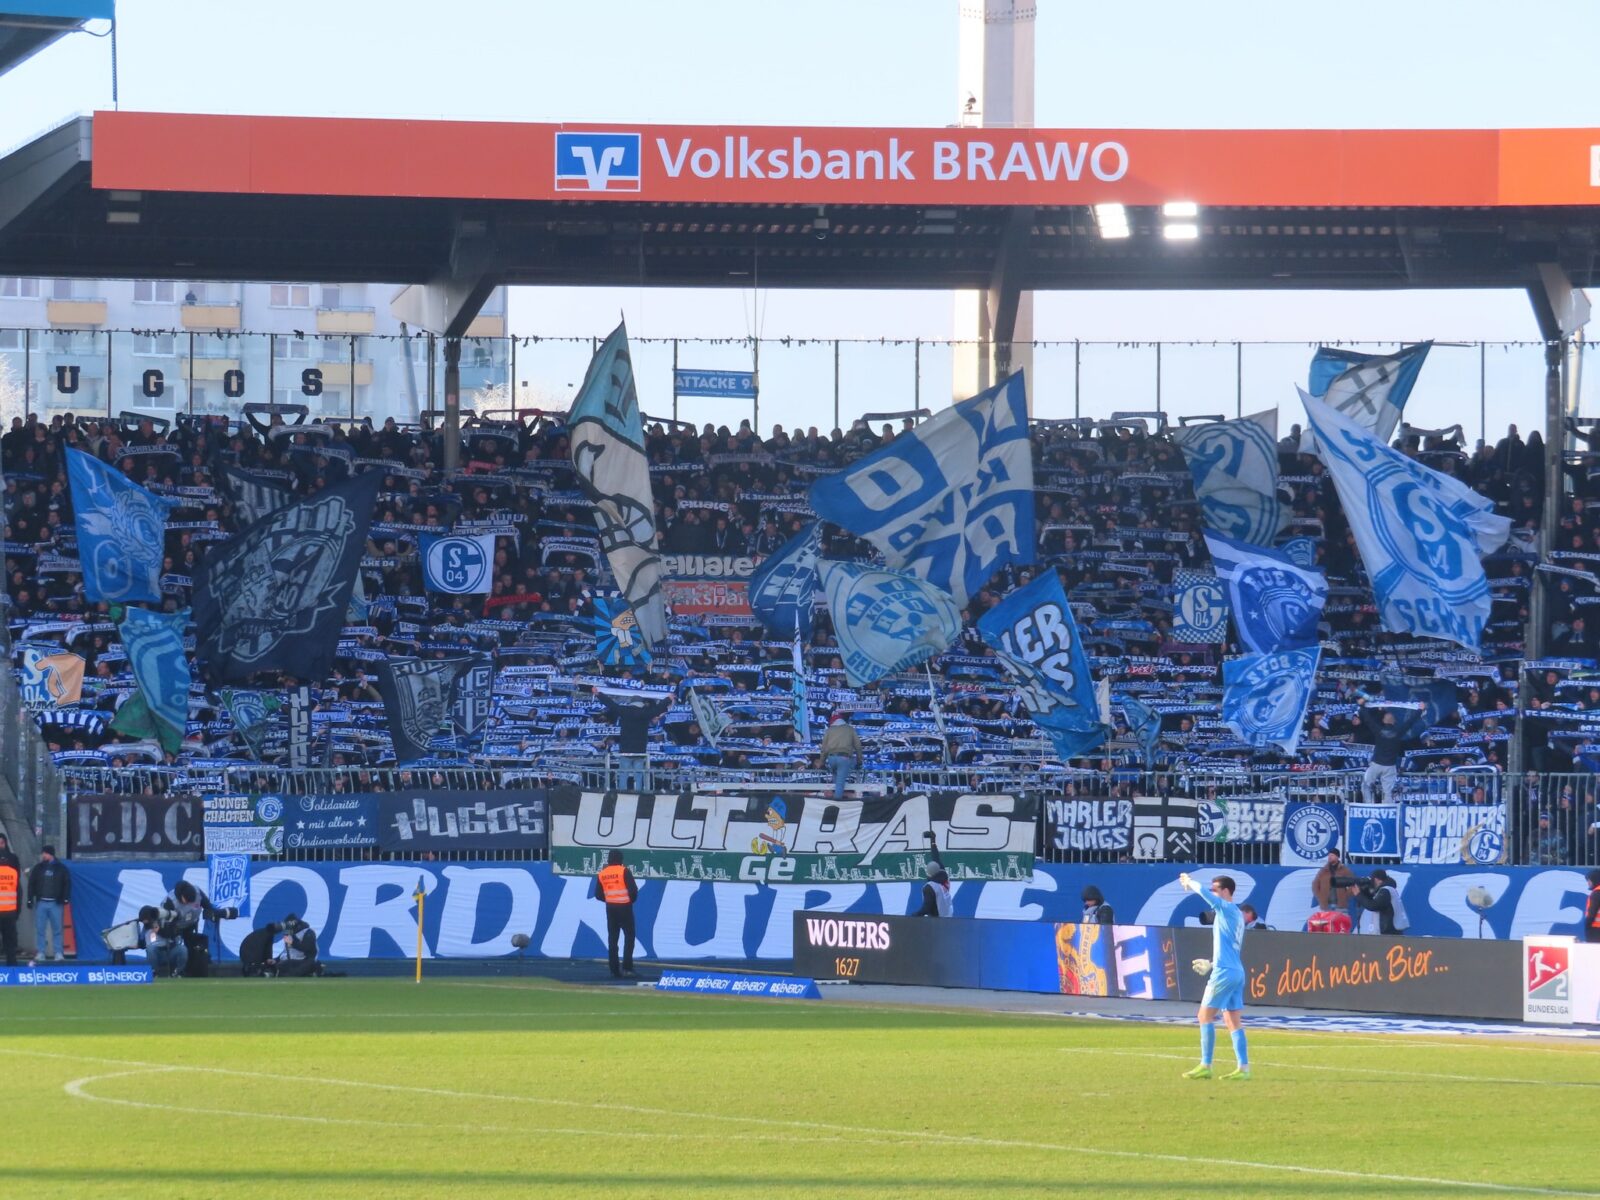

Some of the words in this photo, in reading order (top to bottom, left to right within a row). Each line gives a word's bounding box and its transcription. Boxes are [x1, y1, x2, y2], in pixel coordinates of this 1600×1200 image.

[656, 136, 915, 181] Volksbank
[933, 141, 1129, 182] BRAWO
[676, 375, 736, 390] ATTACKE
[446, 571, 465, 583] 04
[954, 656, 992, 665] SCHALKE
[895, 688, 932, 696] SCHALK
[498, 697, 568, 707] NORDKURVE
[1157, 704, 1217, 712] ORDKURVE
[1540, 710, 1587, 719] SCHALKE
[211, 797, 249, 810] JUNGE
[300, 795, 360, 812] Solidarität
[1228, 801, 1285, 822] BLUE
[204, 810, 254, 823] CHAOTEN
[308, 819, 326, 829] mit
[328, 816, 354, 829] allen
[391, 798, 544, 840] HUGOS
[1047, 799, 1132, 829] MARLER
[1404, 804, 1507, 838] SUPPORTERS
[572, 792, 1015, 866] ULTRAS
[1054, 826, 1129, 850] JUNGS
[1227, 821, 1283, 841] BOYZ
[1403, 837, 1462, 865] CLUB
[216, 868, 243, 885] HARD
[214, 881, 240, 900] KOR
[806, 919, 890, 950] WOLTERS
[835, 957, 859, 977] 1627
[1162, 938, 1177, 988] PILS
[1250, 963, 1268, 998] is'
[1277, 955, 1325, 996] doch
[1329, 953, 1382, 988] mein
[1386, 945, 1449, 983] Bier...
[1556, 973, 1567, 997] 2
[1528, 1004, 1568, 1014] BUNDESLIGA
